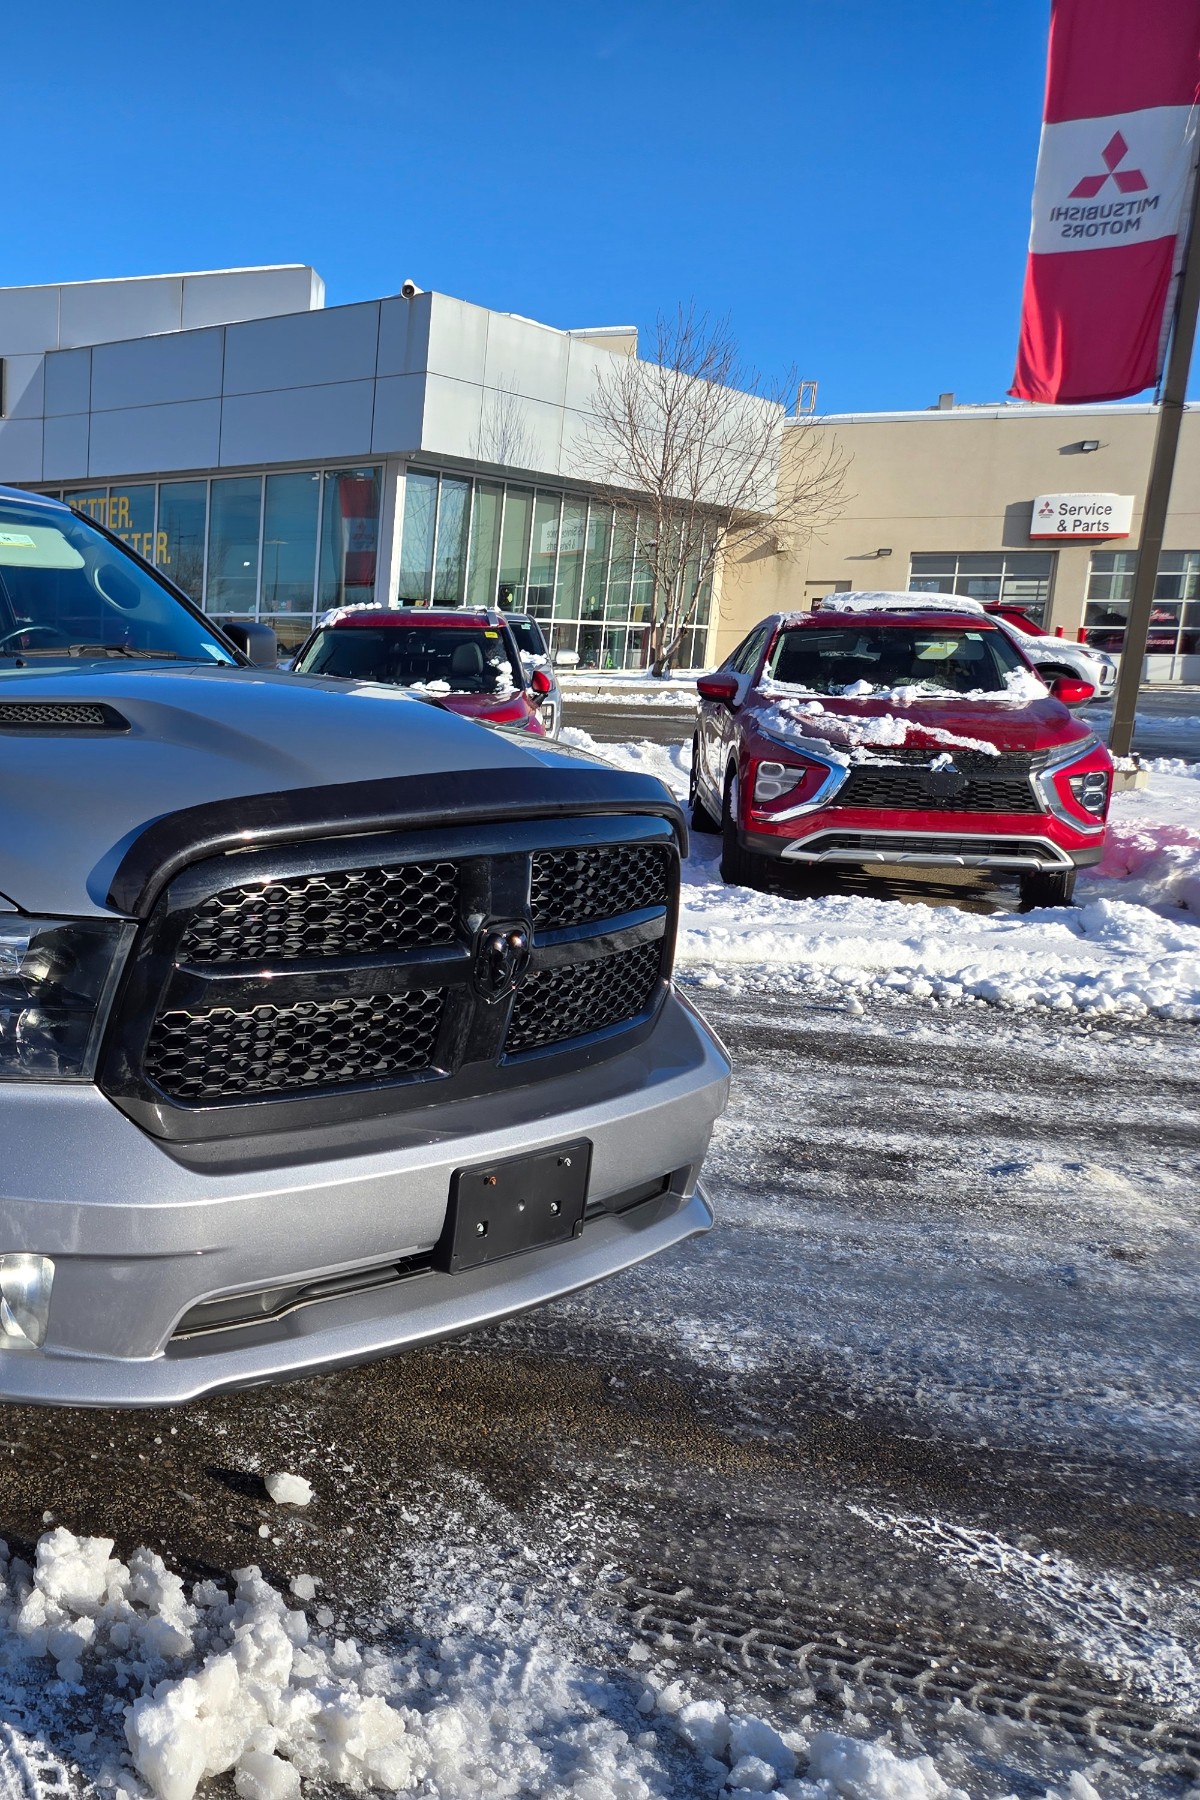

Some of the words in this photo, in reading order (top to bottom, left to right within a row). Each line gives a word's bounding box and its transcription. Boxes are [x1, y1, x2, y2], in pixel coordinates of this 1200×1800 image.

[1058, 502, 1112, 516] Service
[1057, 519, 1067, 532] &
[1072, 519, 1110, 532] Parts
